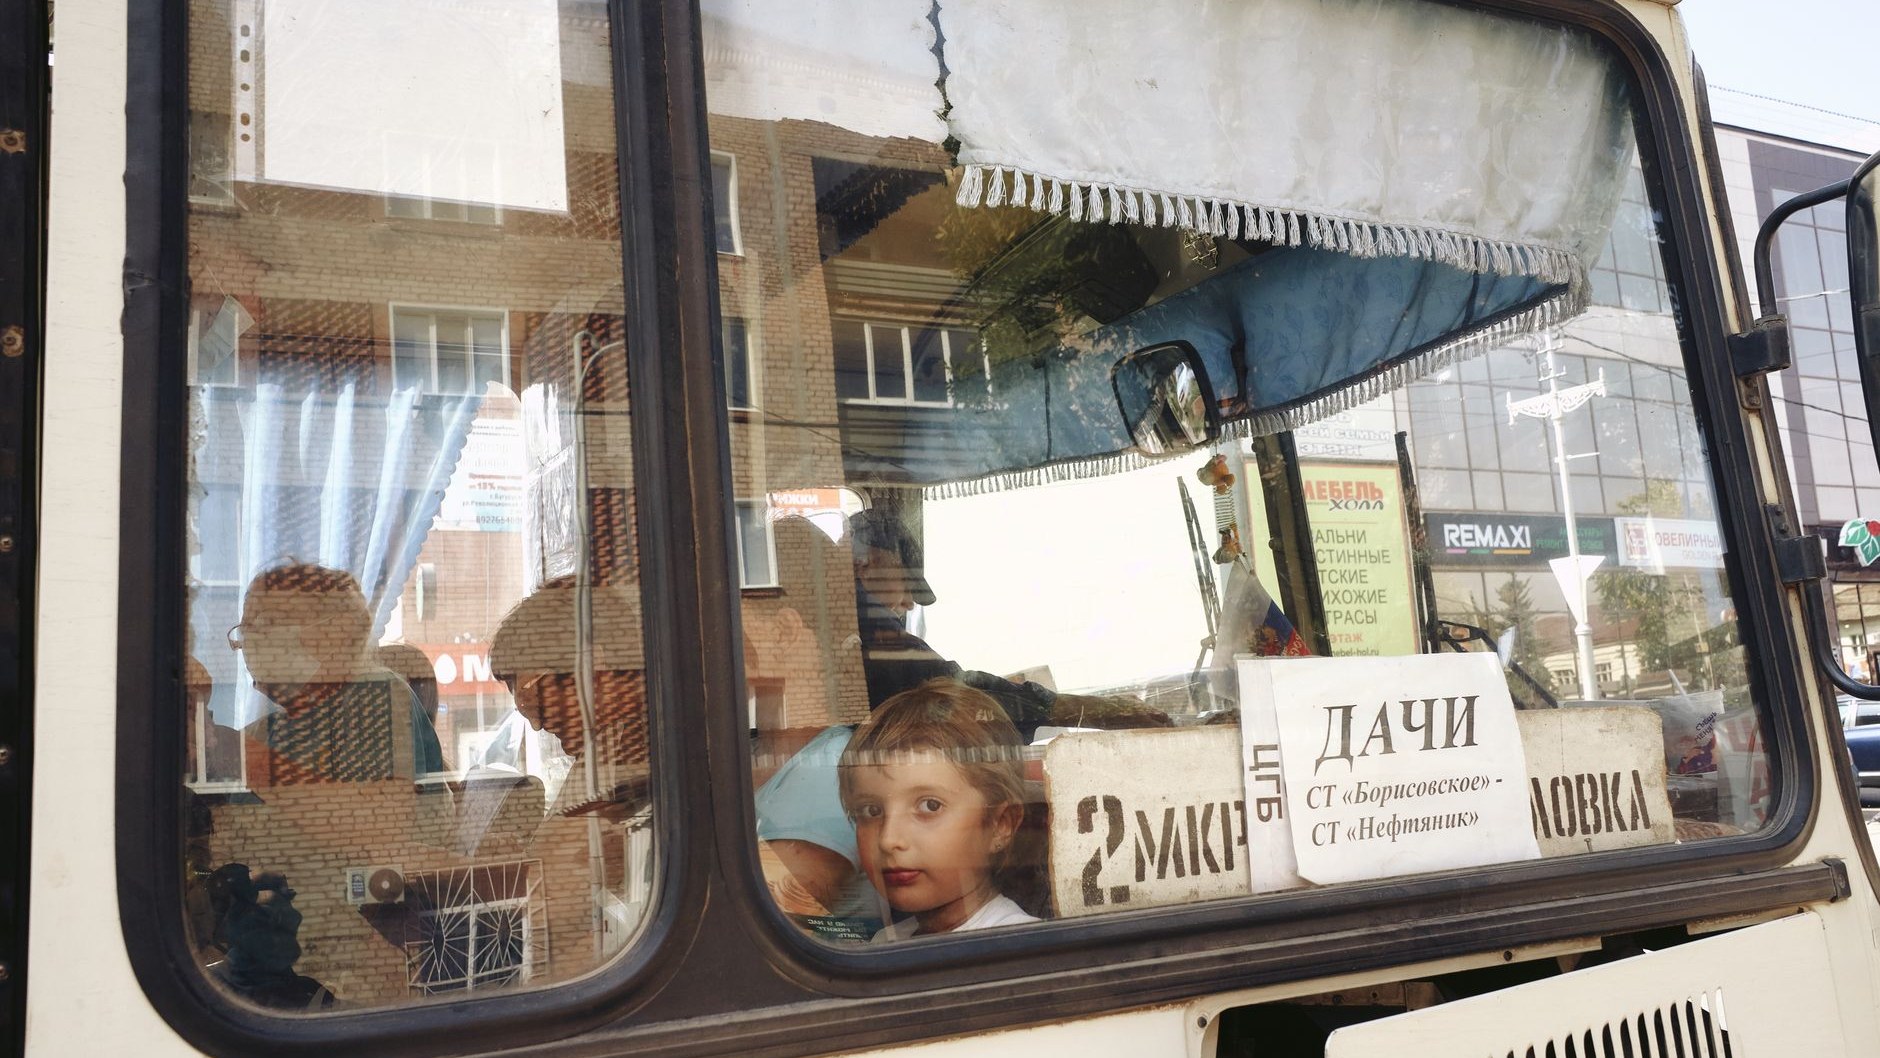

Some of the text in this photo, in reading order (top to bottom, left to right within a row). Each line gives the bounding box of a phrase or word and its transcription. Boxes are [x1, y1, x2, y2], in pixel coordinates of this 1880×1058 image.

[1313, 529, 1367, 544] АЛЬНИ
[1444, 524, 1531, 548] REMAXI
[1316, 549, 1391, 564] СТИННЫЕ
[1318, 569, 1369, 584] ТСКИЕ
[1322, 589, 1388, 604] ИХОЖИЕ
[1326, 609, 1378, 625] ТРАСЫ
[1314, 695, 1479, 776] ДАЧИ
[1249, 744, 1283, 822] ЦГБ
[1306, 784, 1337, 809] СТ
[1342, 774, 1490, 807] «Борисовское»
[1312, 812, 1479, 846] СТ «Нефтяник»
